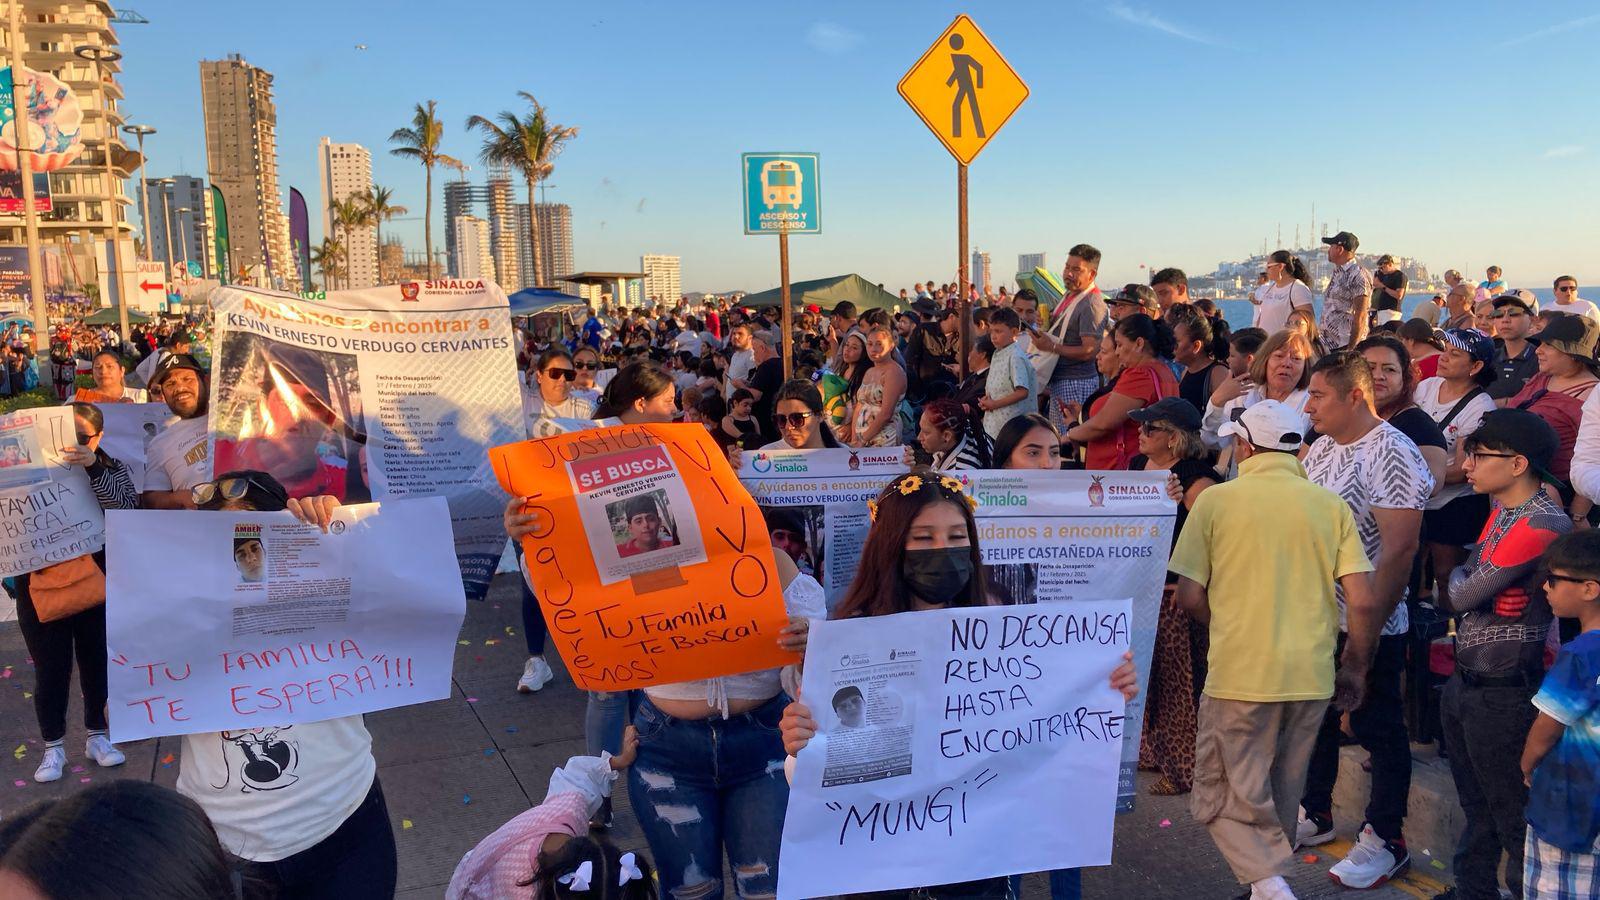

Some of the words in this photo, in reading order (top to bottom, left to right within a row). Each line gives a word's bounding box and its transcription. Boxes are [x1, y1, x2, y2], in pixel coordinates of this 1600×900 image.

[760, 212, 800, 220] ASCENSO
[801, 212, 808, 220] Y
[760, 221, 807, 229] DESCENSO
[137, 263, 163, 273] SALIDA
[425, 280, 485, 290] SINALOA
[227, 312, 271, 335] KEVIN
[273, 326, 338, 348] ERNESTO
[341, 337, 417, 354] VERDUGO
[421, 336, 509, 354] CERVANTES
[369, 316, 471, 334] encontrar
[478, 316, 491, 331] a
[580, 470, 604, 488] SE
[607, 457, 669, 481] BUSCA
[774, 463, 808, 473] Sinaloa
[589, 488, 612, 500] KEVIN
[612, 480, 644, 493] ERNESTO
[644, 472, 676, 484] VERDUGO
[615, 482, 656, 497] CERVANTES
[757, 480, 817, 497] Ayúdanos
[821, 481, 829, 491] a
[1108, 485, 1160, 496] SINALOA
[0, 482, 75, 518] FAMILIA
[774, 495, 814, 505] ERNESTO
[815, 494, 859, 504] VERDUGO
[978, 490, 1028, 506] Sinaloa
[20, 519, 93, 553] ERNESTO
[1043, 528, 1053, 540] a
[1059, 523, 1145, 540] encontrar
[1150, 528, 1160, 538] a
[987, 547, 1025, 561] FELIPE
[1028, 543, 1105, 559] CASTAÑEDA
[1108, 545, 1153, 560] FLORES
[951, 616, 989, 651] NO
[998, 611, 1129, 651] DESCANSA
[219, 639, 364, 674] FAMILIA
[944, 655, 1042, 684] REMOS
[127, 695, 191, 725] TE
[945, 684, 1032, 722] HASTA
[940, 707, 1125, 759] ENCONTRARTE
